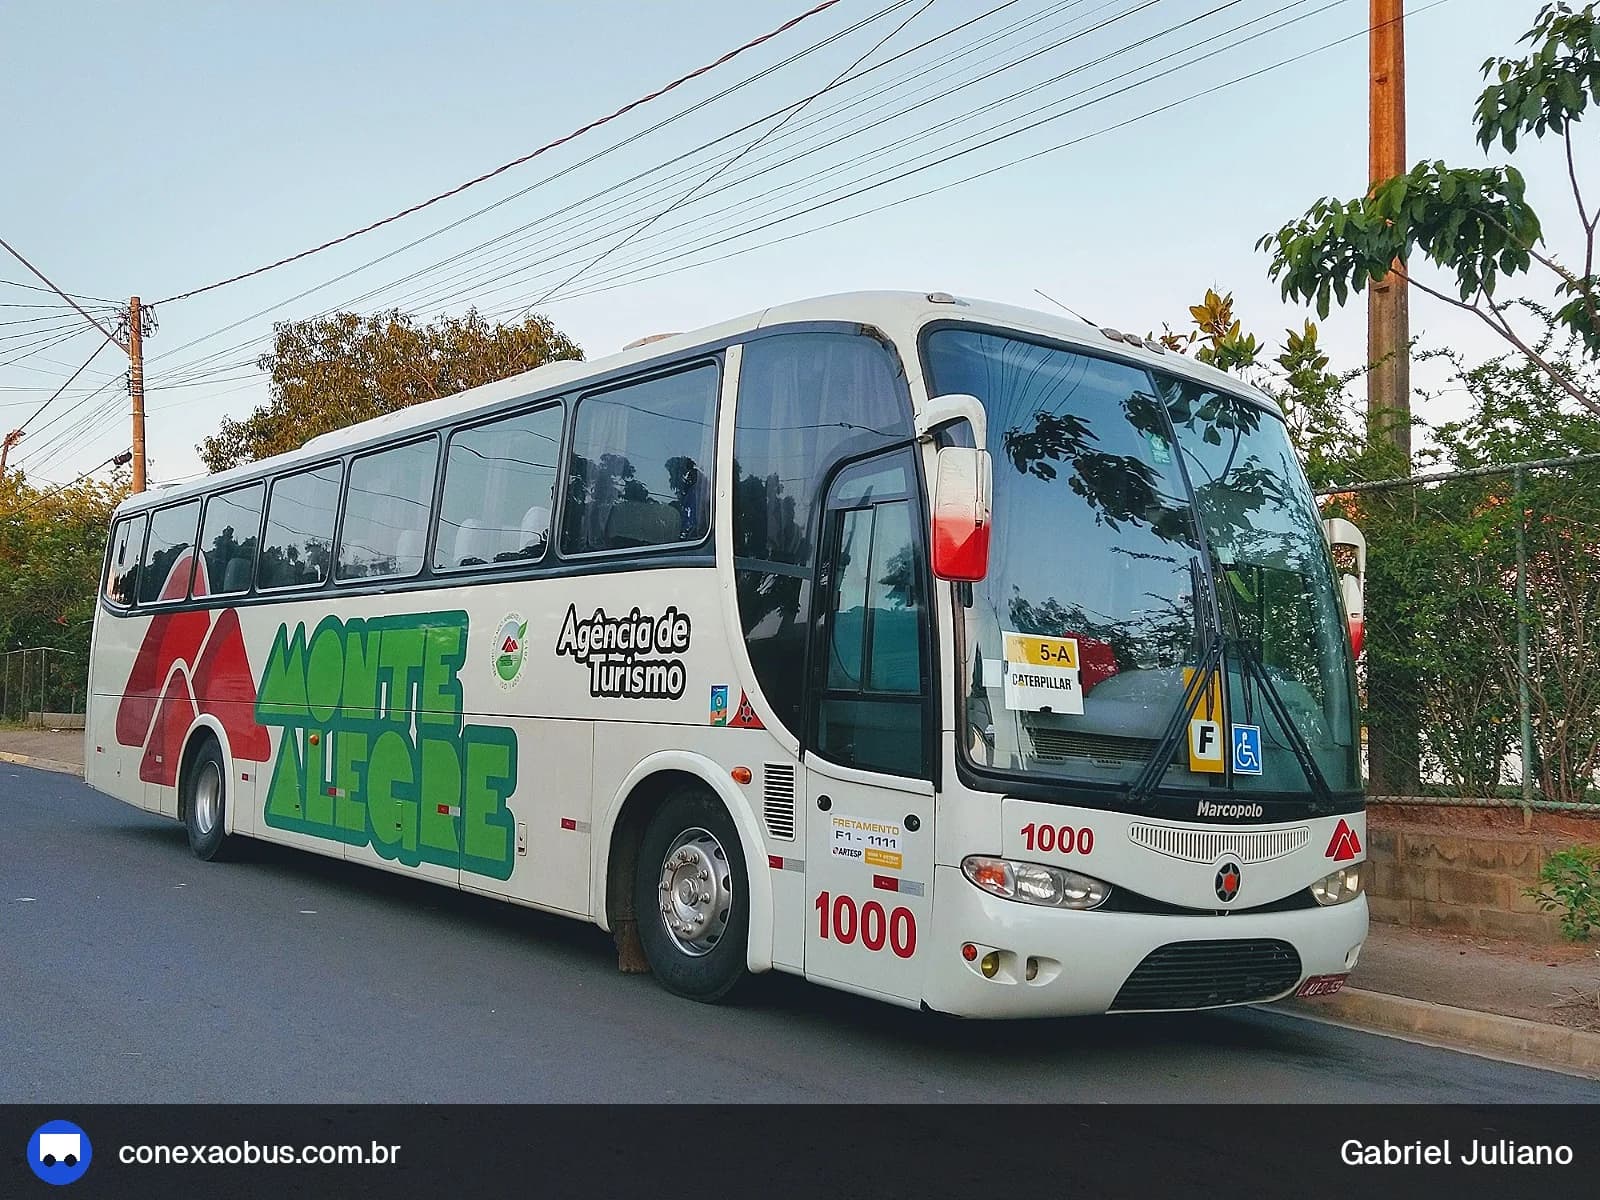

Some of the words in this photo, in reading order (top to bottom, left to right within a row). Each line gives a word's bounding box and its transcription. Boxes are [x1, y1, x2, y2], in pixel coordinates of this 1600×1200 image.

[557, 604, 653, 661] Agência
[655, 608, 690, 652] de
[1040, 643, 1071, 663] 5-A
[256, 616, 466, 729] MONTE
[588, 654, 685, 697] Turismo
[1012, 673, 1072, 691] CATERPILLAR
[1198, 725, 1214, 754] F
[266, 726, 514, 869] ALEGRE
[1196, 800, 1263, 819] Marcopolo
[832, 817, 900, 836] FRETAMENTO
[835, 830, 852, 841] F1
[867, 835, 897, 849] 1111
[1020, 822, 1095, 856] 1000
[838, 847, 862, 859] ARTESP
[815, 890, 918, 960] 1000
